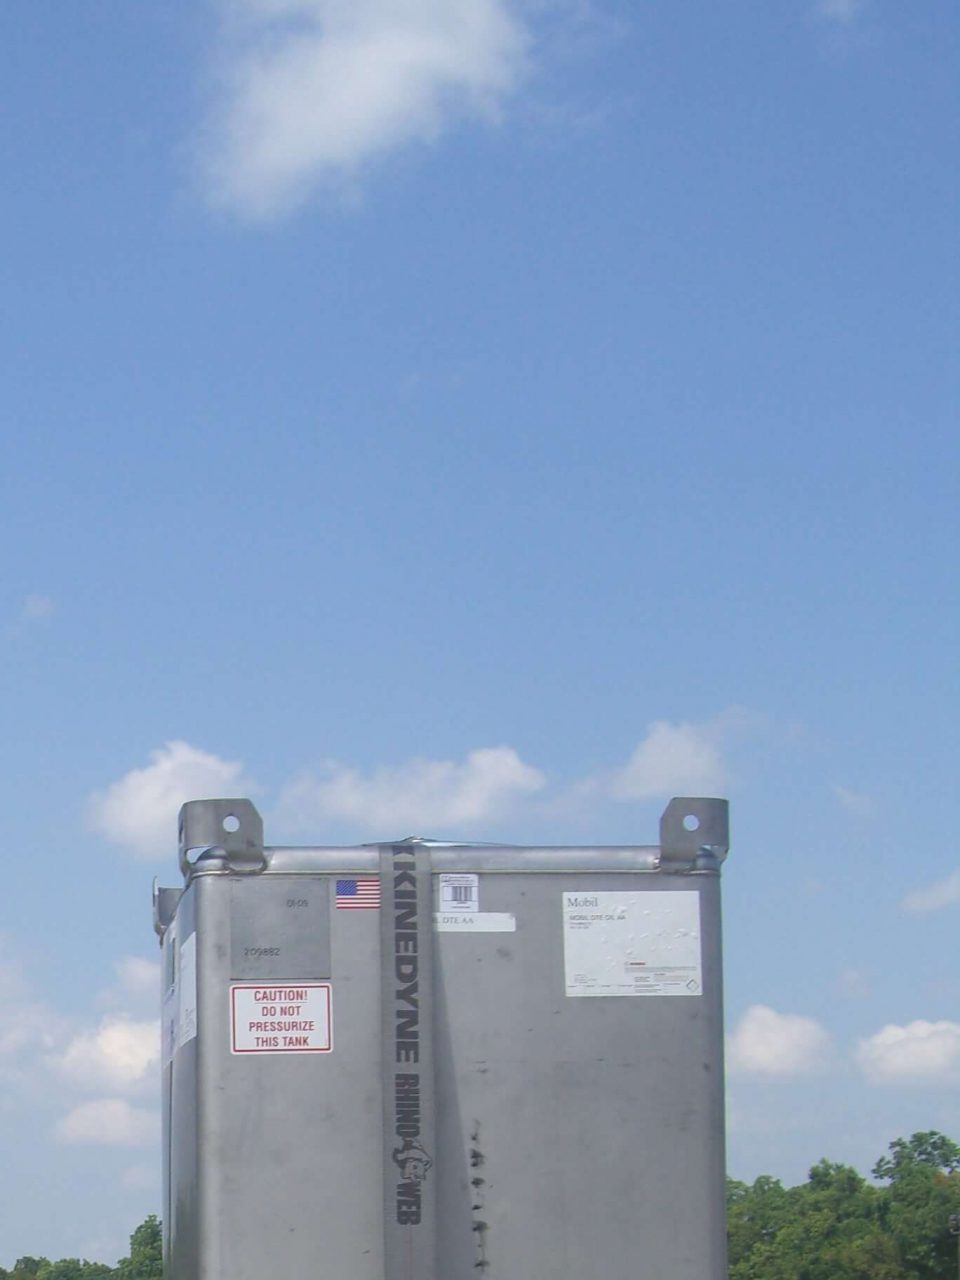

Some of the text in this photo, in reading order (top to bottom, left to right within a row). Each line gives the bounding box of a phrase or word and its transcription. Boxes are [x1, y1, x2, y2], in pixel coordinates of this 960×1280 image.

[567, 897, 599, 908] Mobil
[254, 989, 308, 1002] CAUTION!
[261, 1005, 302, 1017] DO NOT
[248, 1020, 315, 1032] PRESSURIZE
[254, 1036, 310, 1047] THIS TANK
[393, 861, 422, 1226] KINEDYNE RHINO WEB
